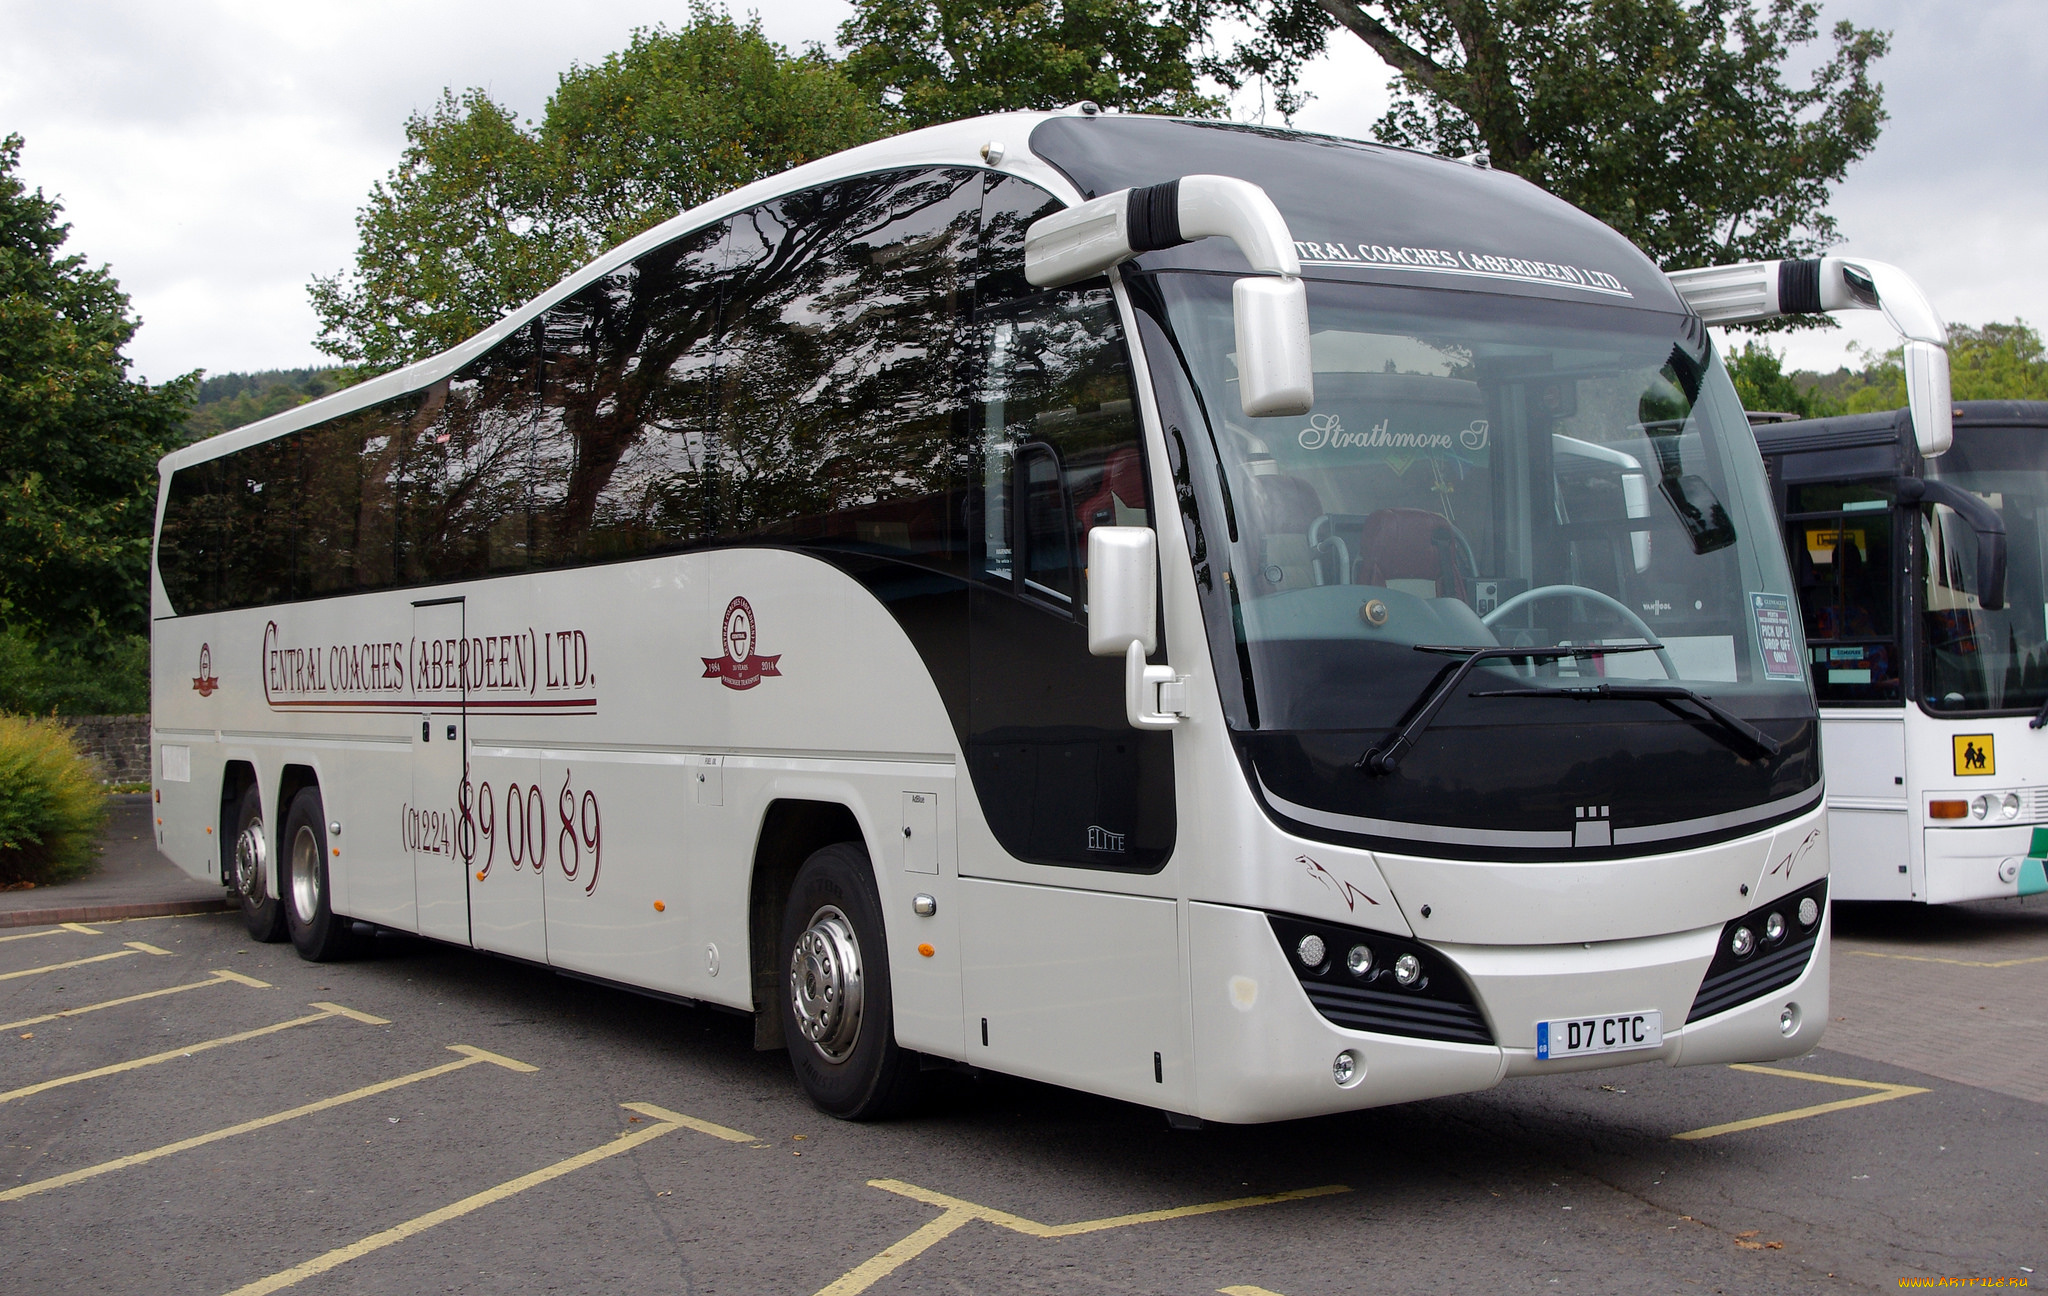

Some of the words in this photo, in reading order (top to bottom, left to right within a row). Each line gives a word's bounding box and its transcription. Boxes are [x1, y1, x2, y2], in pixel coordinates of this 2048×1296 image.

[1292, 241, 1361, 260] TRAL
[1358, 244, 1459, 269] COACHES
[1458, 250, 1584, 285] (ABERDEEN)
[1582, 268, 1628, 292] LTD.
[1298, 413, 1452, 450] Strathmore
[1761, 624, 1776, 637] PICK
[1775, 625, 1784, 638] UP
[1784, 626, 1790, 639] &
[1780, 638, 1791, 651] OFF
[263, 620, 327, 706] CENTRAL
[329, 641, 404, 693] COACHES
[410, 627, 537, 696] (ABERDEEN)
[545, 629, 596, 689] LTD.
[761, 661, 775, 671] 2014
[507, 782, 547, 875] 00
[559, 767, 602, 897] 89
[1088, 828, 1125, 851] ELITE
[1567, 1021, 1596, 1050] D7
[1603, 1016, 1645, 1046] CTC
